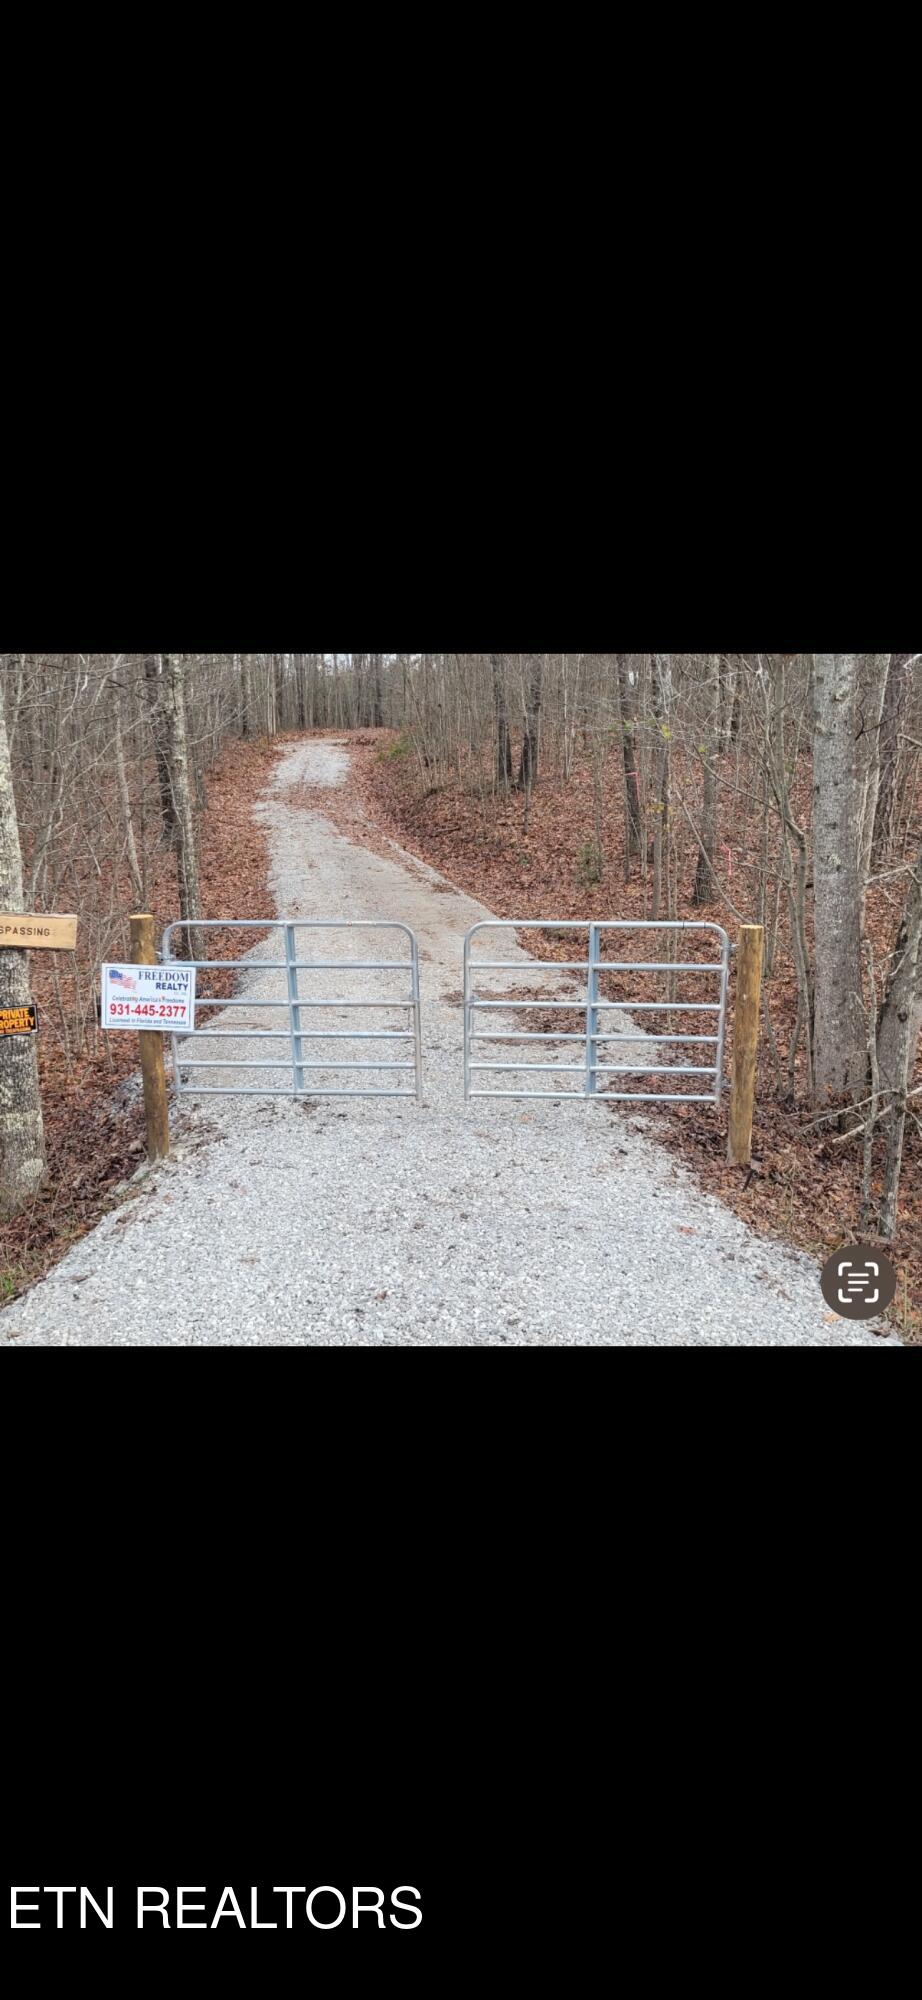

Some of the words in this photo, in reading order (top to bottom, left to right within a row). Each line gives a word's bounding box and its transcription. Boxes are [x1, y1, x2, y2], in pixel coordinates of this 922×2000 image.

[138, 970, 189, 982] FREEDOM
[155, 982, 188, 991] REALTY
[110, 1003, 187, 1018] 931-445-2377
